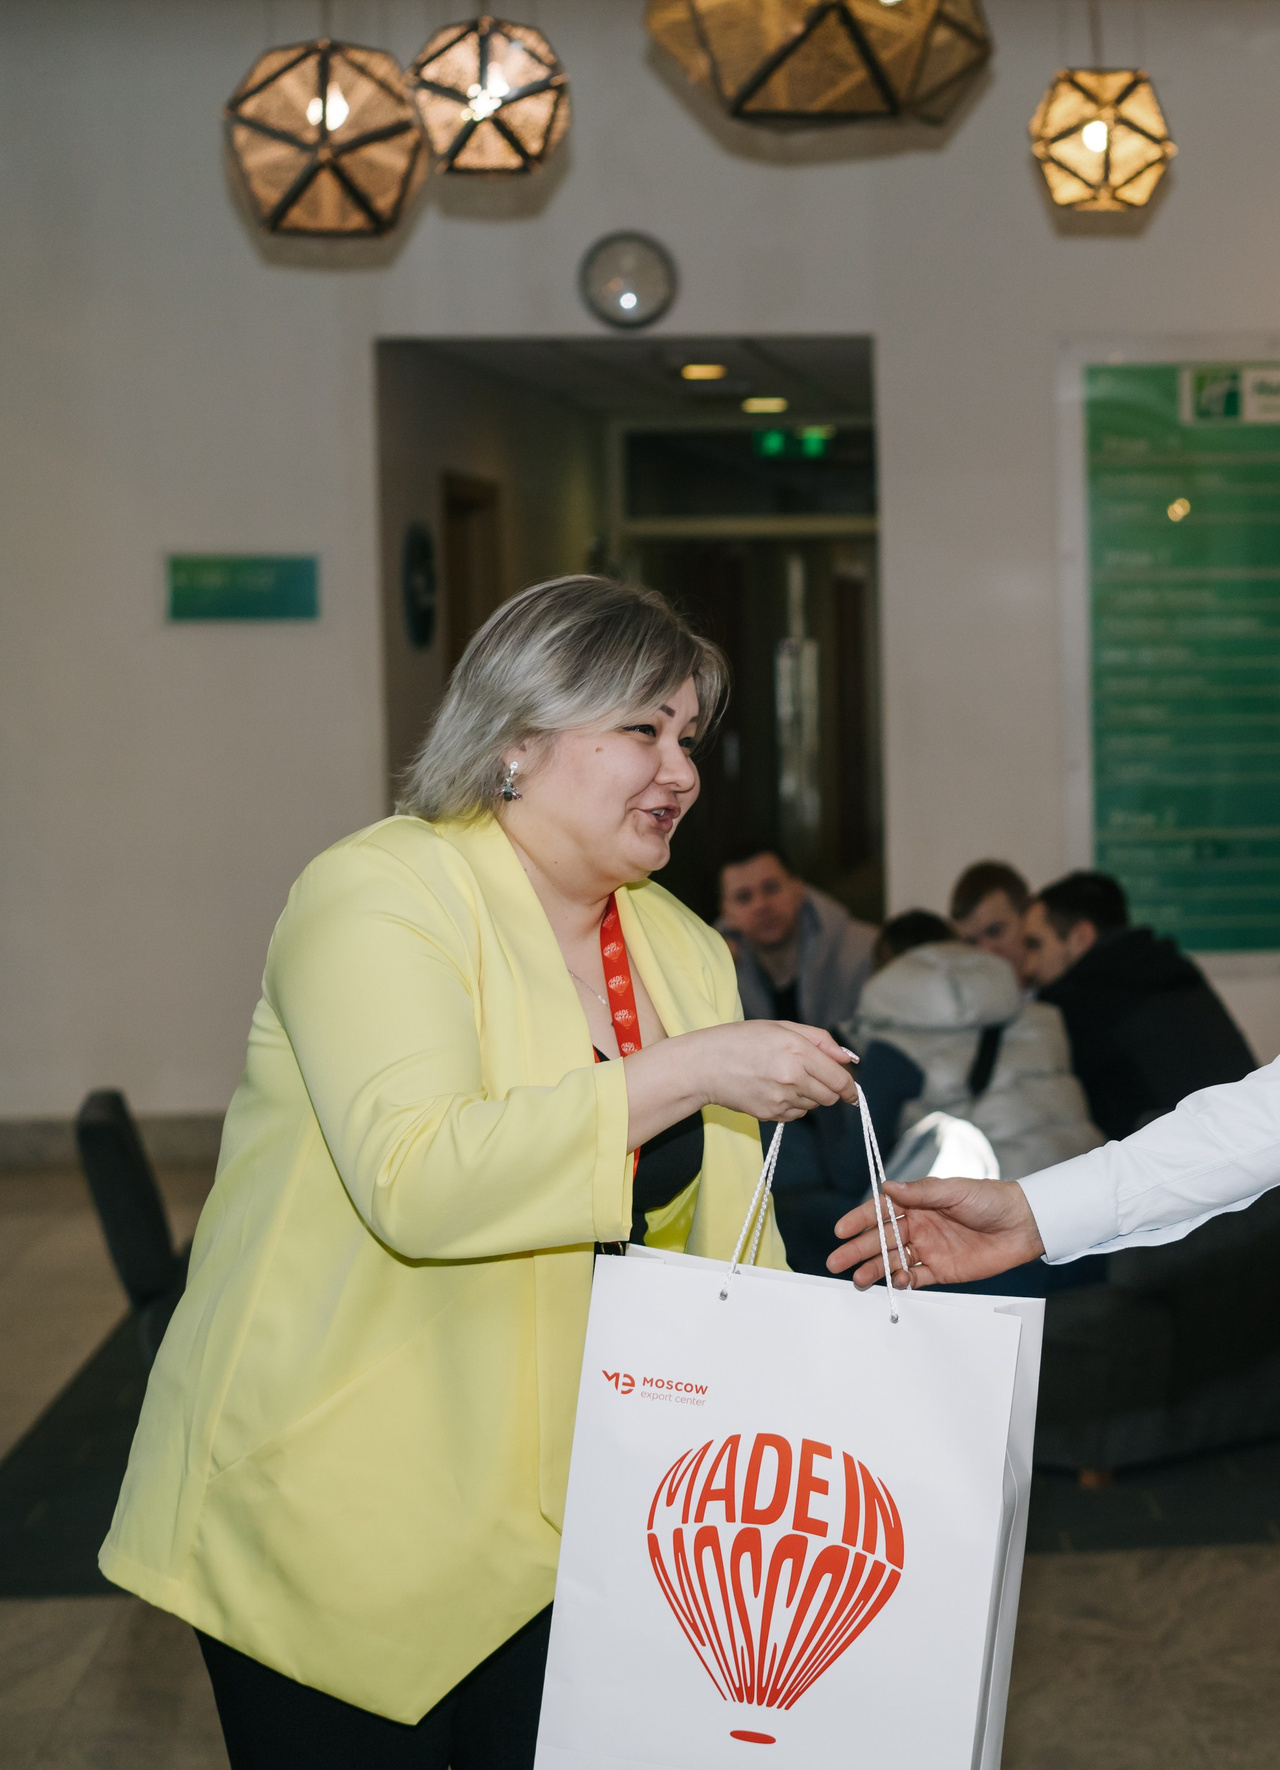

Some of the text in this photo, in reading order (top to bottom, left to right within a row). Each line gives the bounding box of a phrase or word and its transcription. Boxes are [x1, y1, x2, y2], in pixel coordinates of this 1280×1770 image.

[640, 1390, 706, 1407] export center
[642, 1376, 709, 1396] MOSCOW
[646, 1433, 905, 1570] MADE IN
[646, 1525, 902, 1711] MOSCOW
